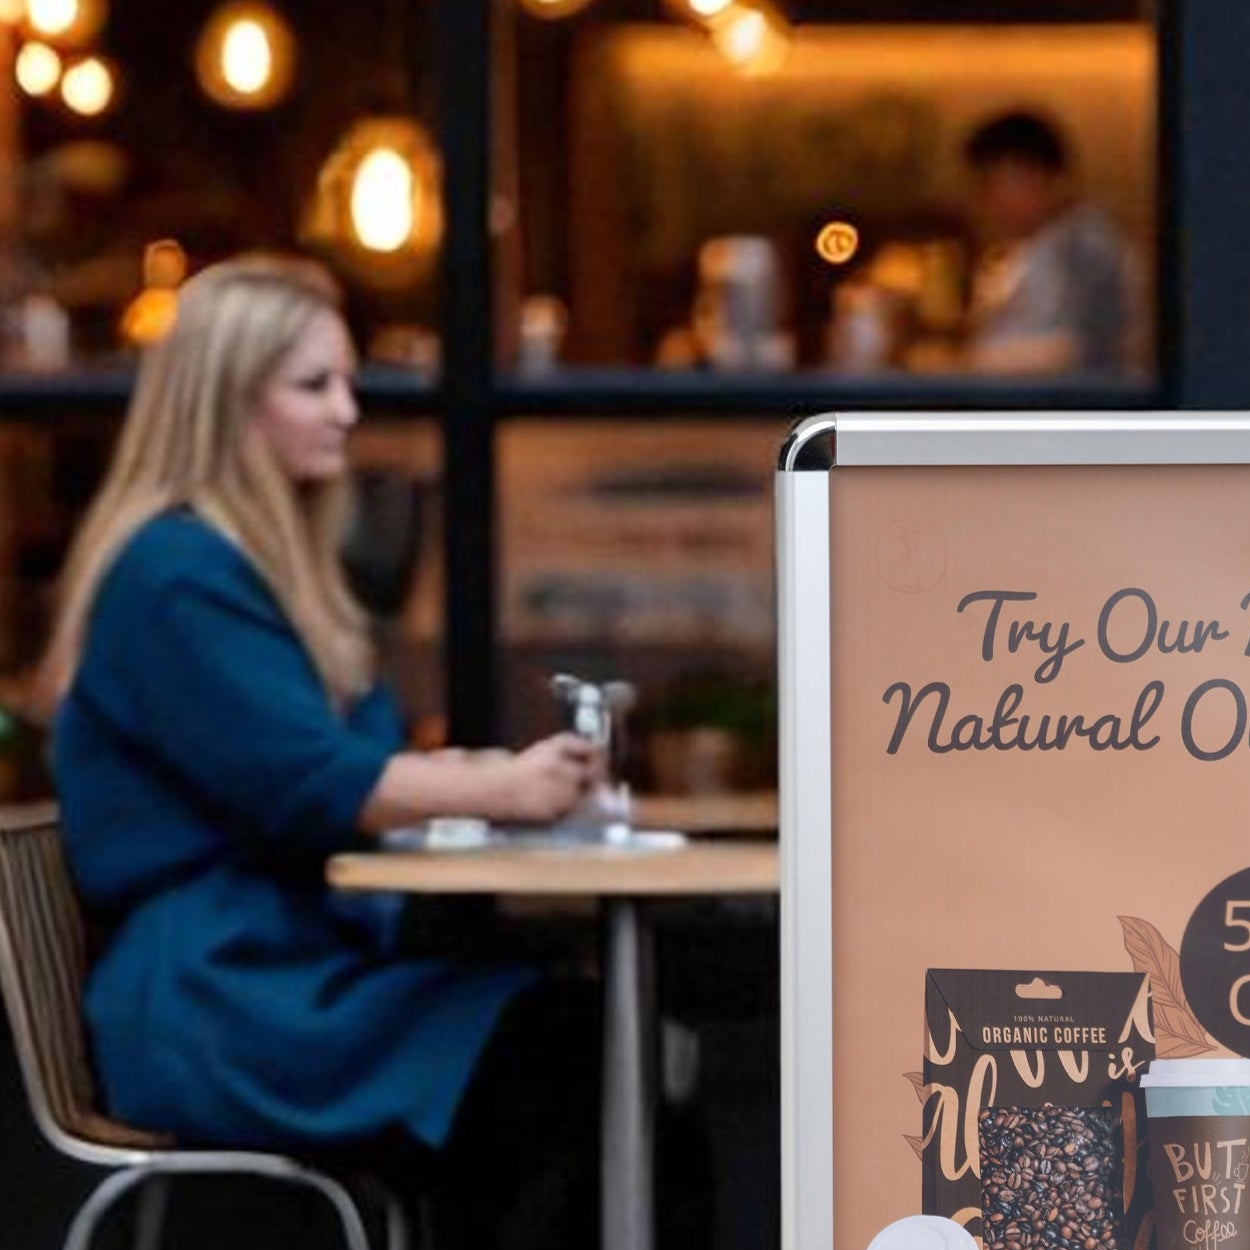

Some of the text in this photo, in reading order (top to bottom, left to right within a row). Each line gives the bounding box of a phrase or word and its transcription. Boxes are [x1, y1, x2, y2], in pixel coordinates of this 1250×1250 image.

[957, 590, 1085, 684] Try
[1097, 587, 1229, 664] Our
[882, 680, 1165, 756] Natural
[982, 1026, 1107, 1044] ORGANIC COFFEE
[1013, 1015, 1075, 1023] 100% NATURAL
[1163, 1138, 1247, 1183] BUT
[1172, 1183, 1246, 1215] FIRST
